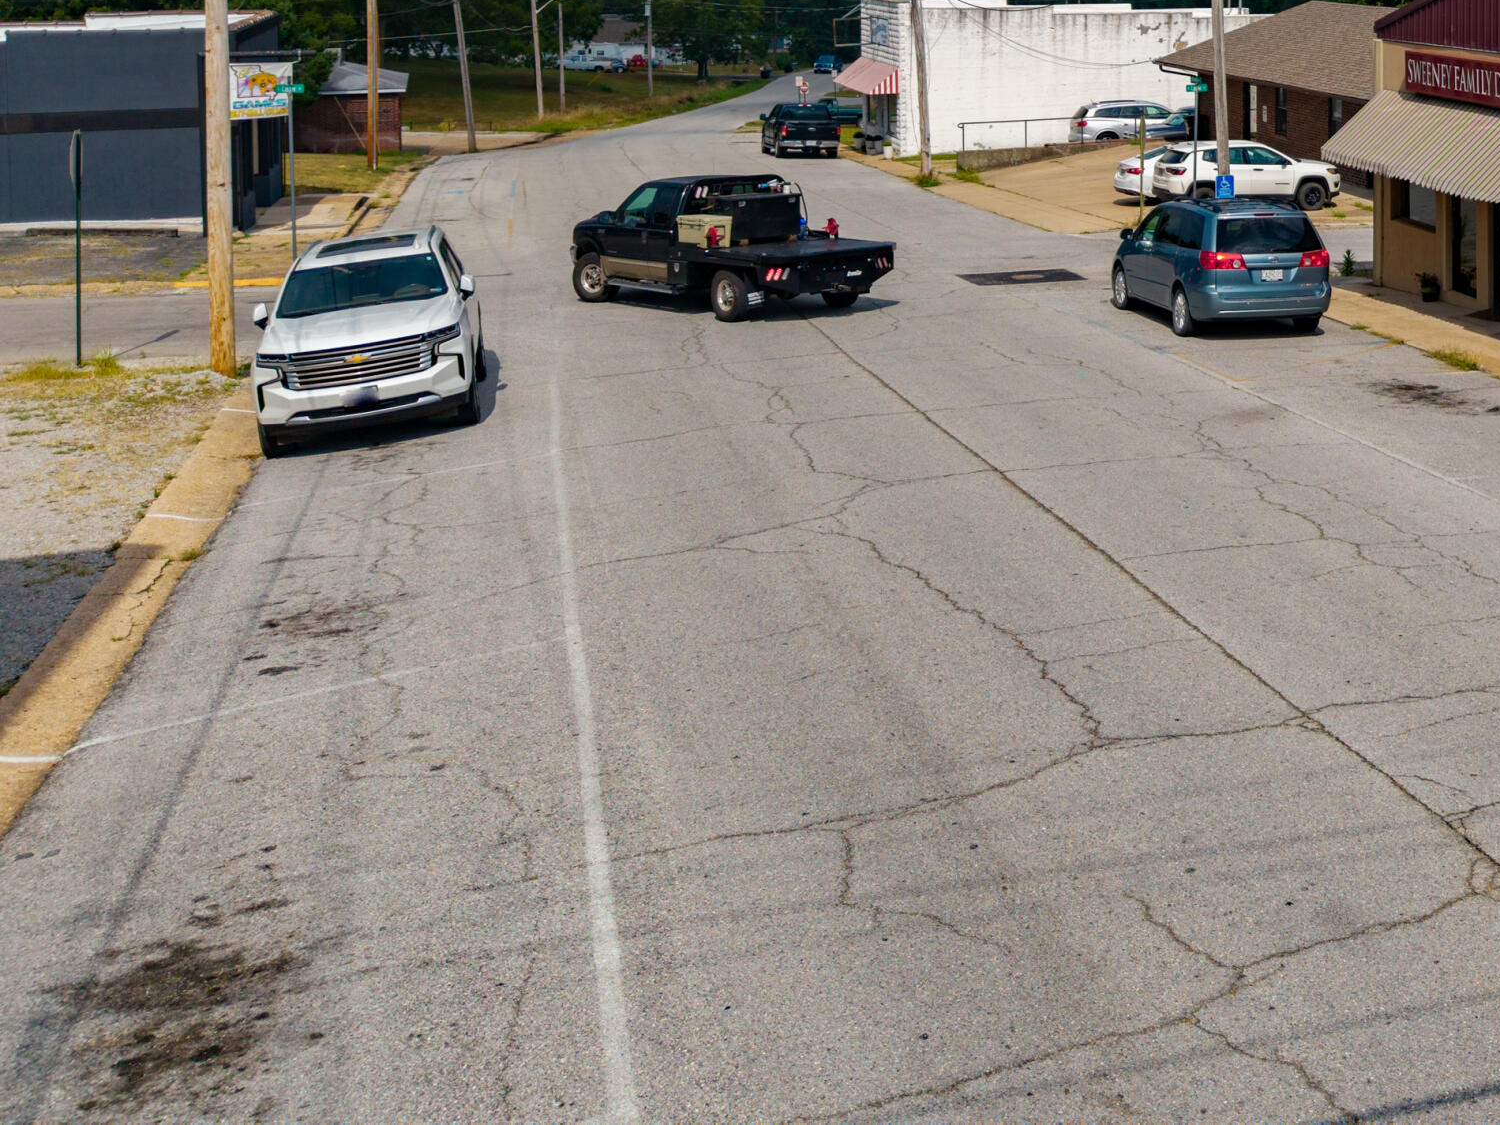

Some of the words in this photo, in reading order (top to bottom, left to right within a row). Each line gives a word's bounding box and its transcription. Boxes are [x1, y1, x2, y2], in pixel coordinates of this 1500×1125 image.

[1407, 58, 1452, 90] SWEENEY
[1454, 66, 1493, 97] FAMILY
[232, 98, 287, 109] GAMES
